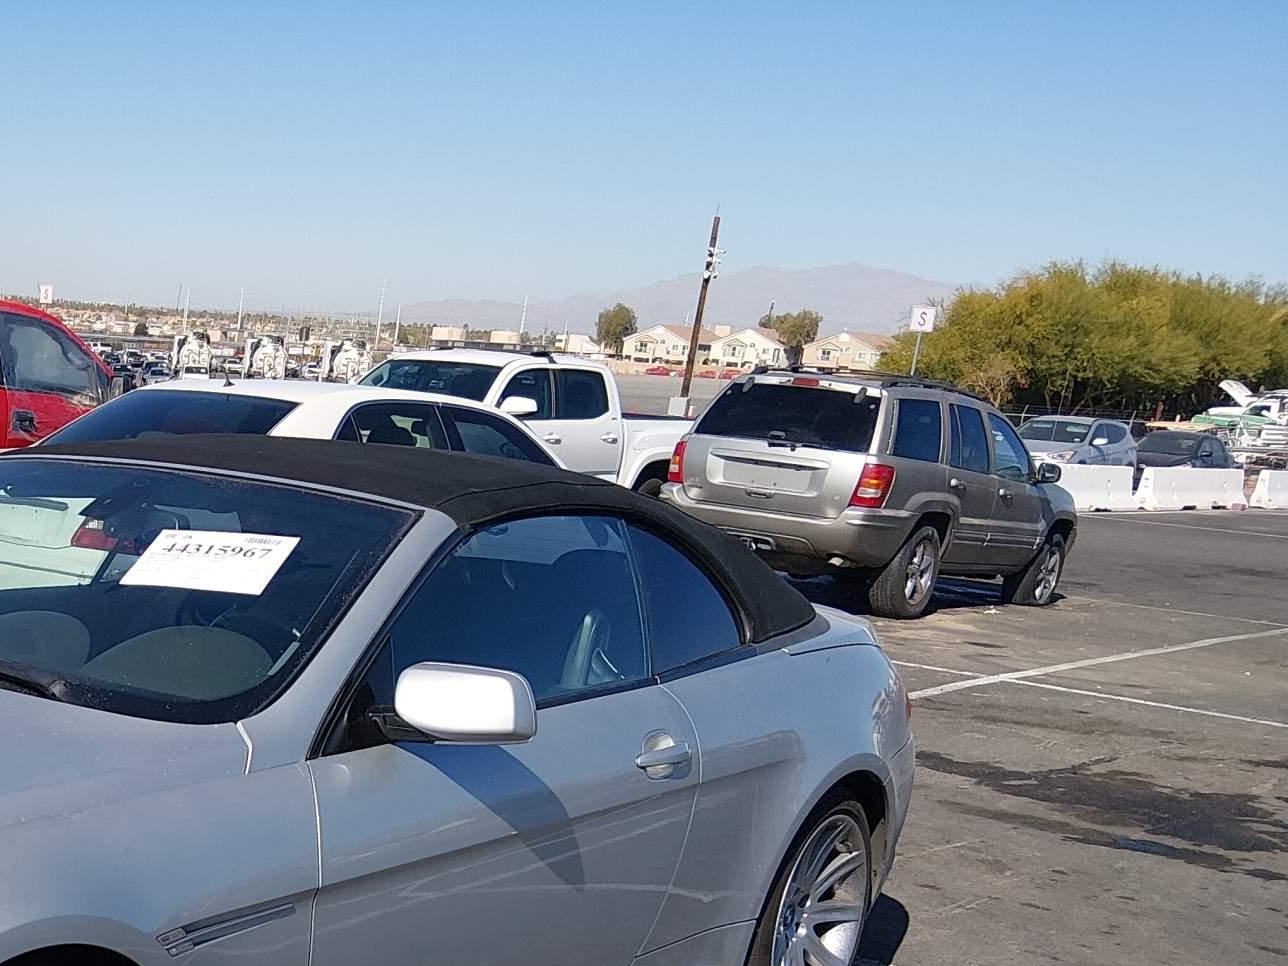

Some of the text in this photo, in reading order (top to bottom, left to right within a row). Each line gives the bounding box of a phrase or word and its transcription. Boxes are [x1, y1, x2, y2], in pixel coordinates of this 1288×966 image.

[43, 288, 49, 300] S
[918, 311, 928, 326] S
[162, 542, 273, 559] 44315967
